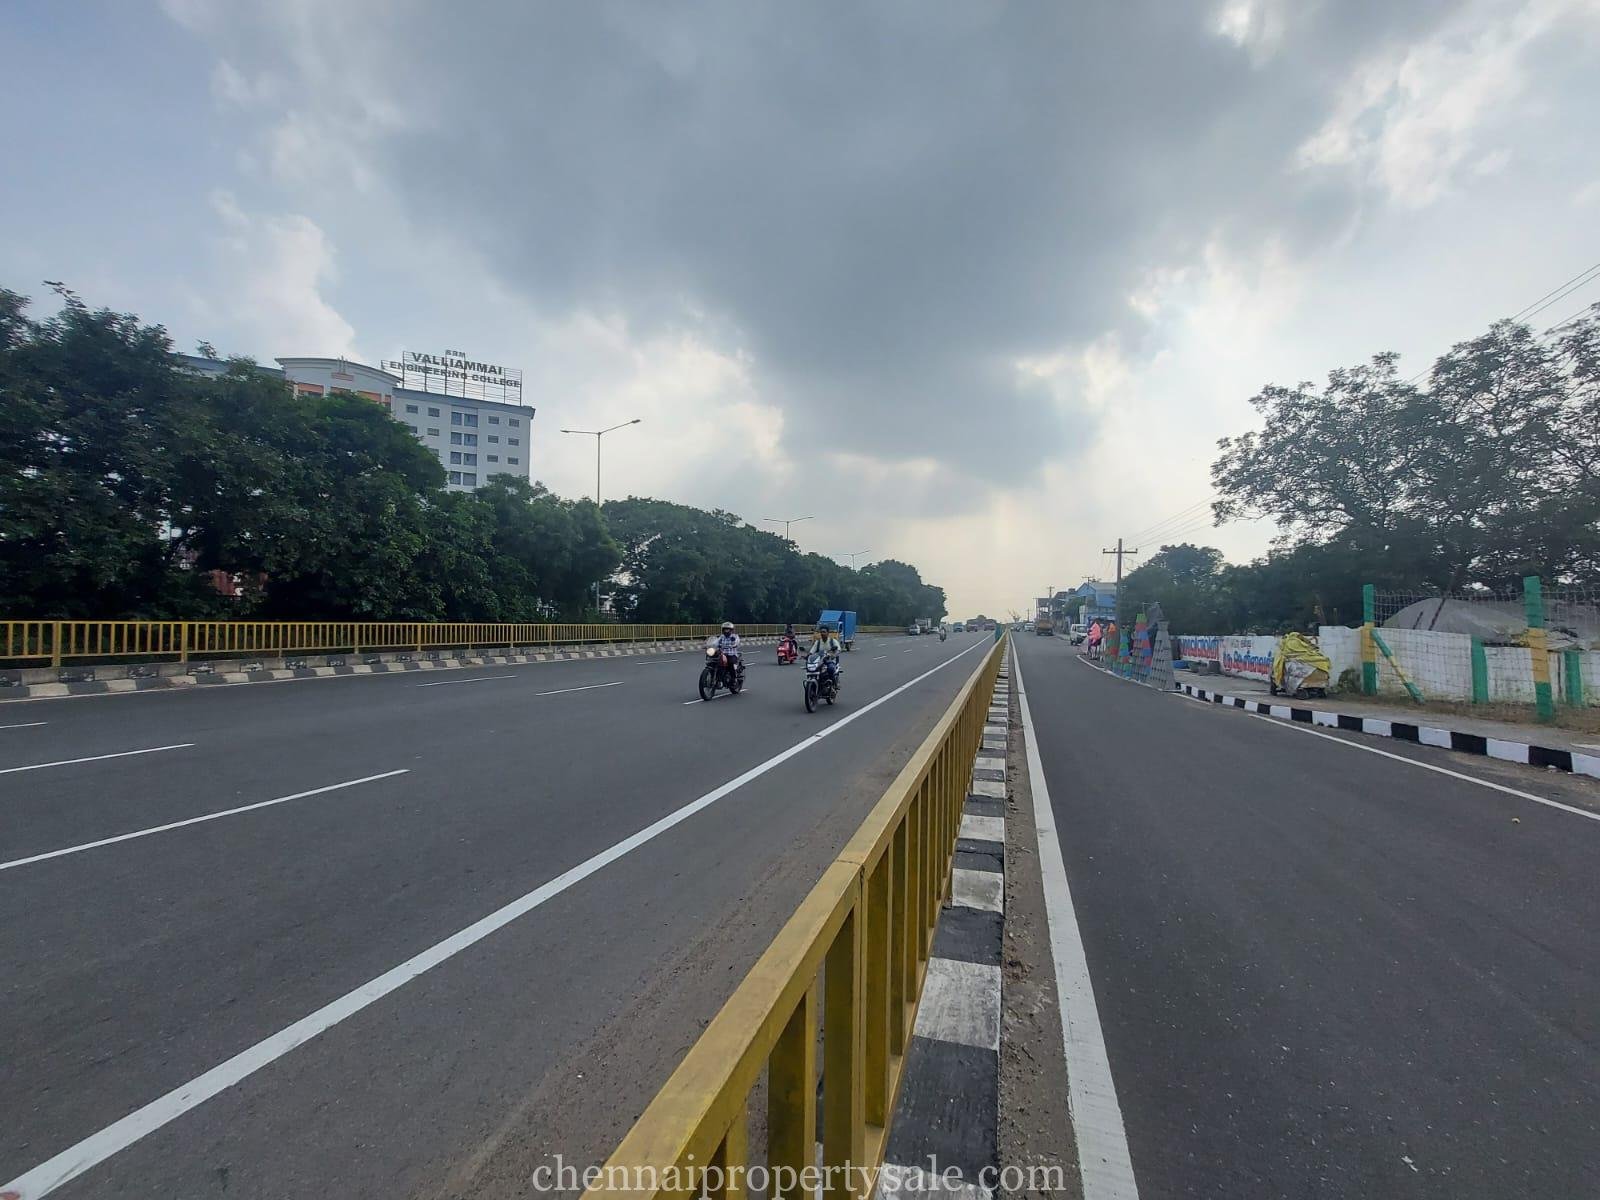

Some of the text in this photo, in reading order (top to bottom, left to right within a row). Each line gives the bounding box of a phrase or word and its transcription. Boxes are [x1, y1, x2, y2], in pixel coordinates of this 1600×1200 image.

[390, 361, 520, 387] ENGINEERING COLLEGE
[412, 352, 502, 375] VALLIAMMAI
